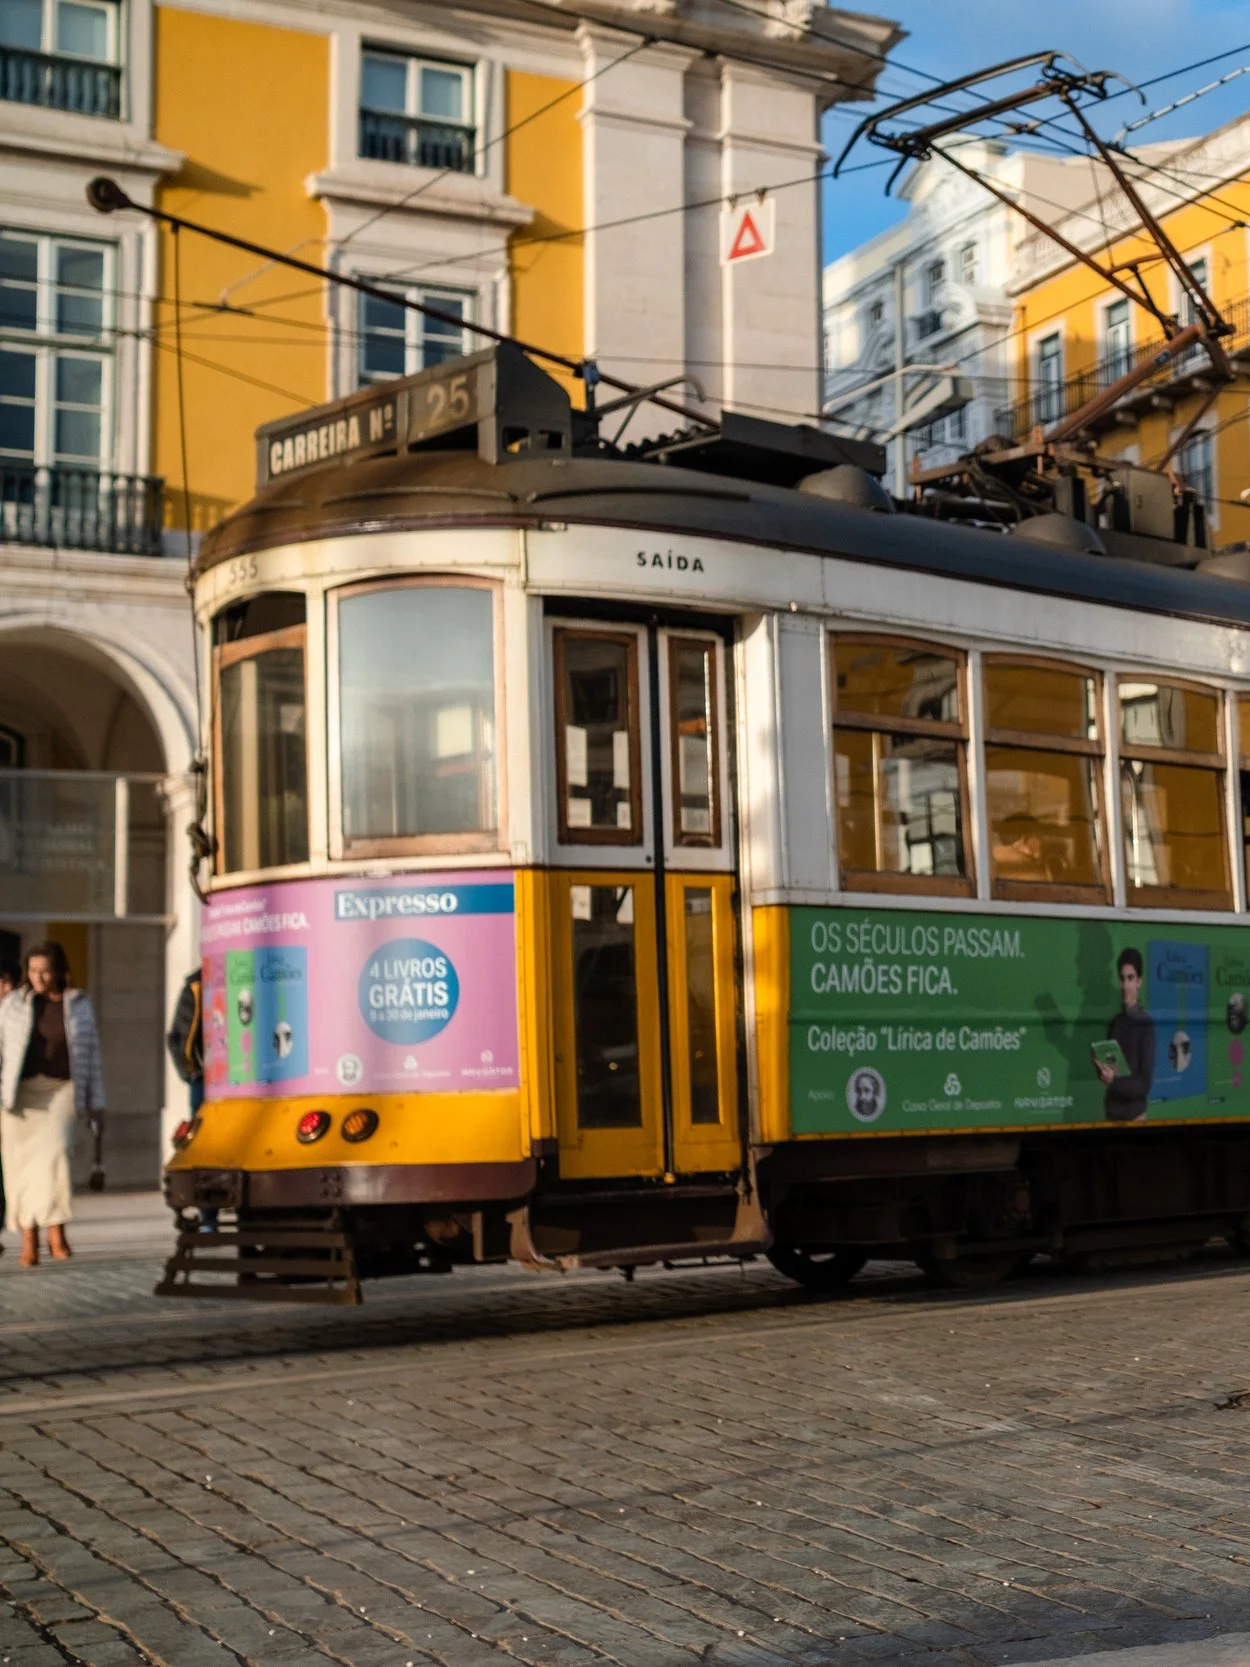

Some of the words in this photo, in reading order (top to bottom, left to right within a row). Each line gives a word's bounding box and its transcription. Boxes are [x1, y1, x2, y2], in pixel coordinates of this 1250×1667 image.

[270, 414, 360, 475] CARREIRA
[426, 375, 470, 428] 25
[637, 548, 704, 573] SAÍDA
[338, 892, 458, 920] Expresso
[811, 921, 842, 953] OS
[846, 917, 940, 956] SÉCULOS
[943, 927, 1026, 958] PASSAM.
[370, 961, 380, 980] 4
[384, 957, 448, 980] LIVROS
[811, 957, 902, 994] CAMÕES
[907, 965, 959, 995] FICA.
[369, 978, 449, 1009] GRÁTIS
[807, 1025, 878, 1057] Coleção
[880, 1025, 932, 1050] "Lírica
[936, 1027, 956, 1050] de
[959, 1025, 1028, 1051] Camões"
